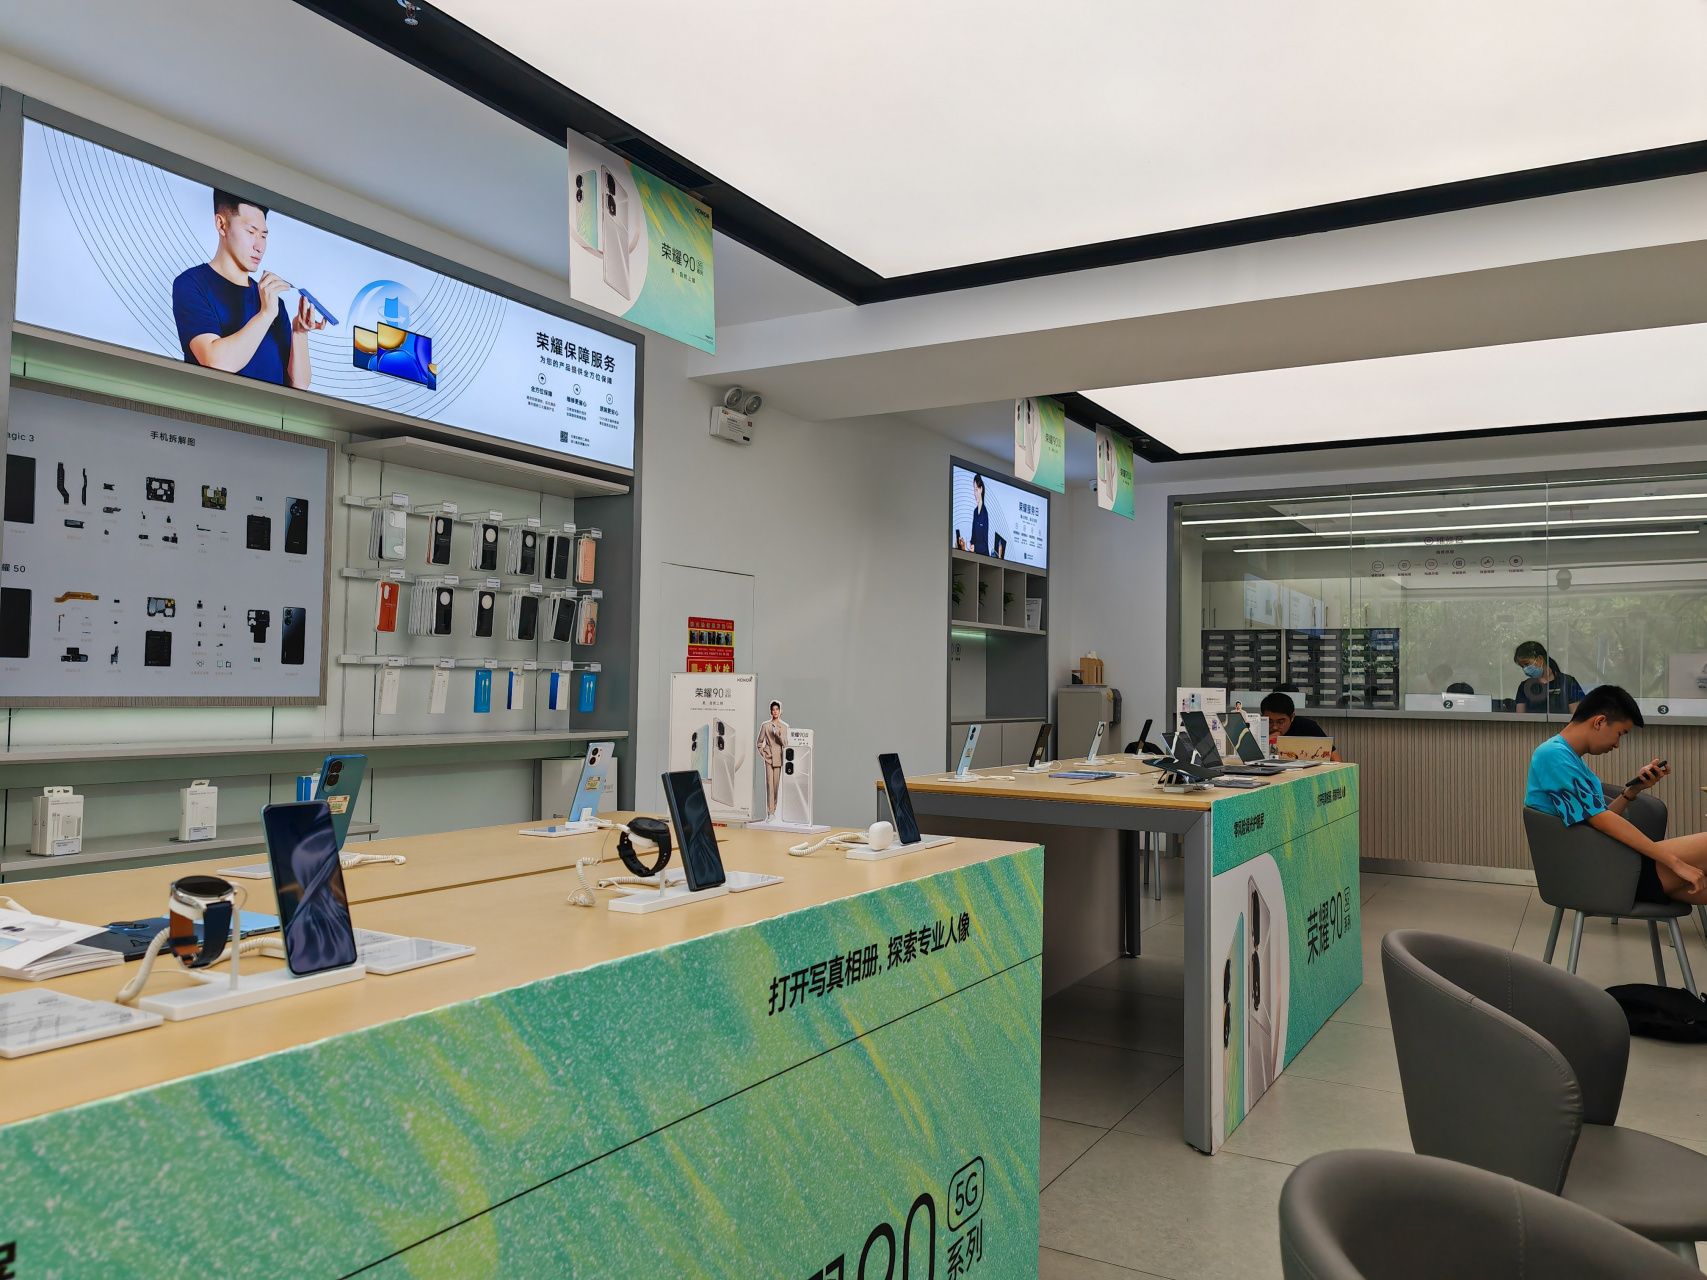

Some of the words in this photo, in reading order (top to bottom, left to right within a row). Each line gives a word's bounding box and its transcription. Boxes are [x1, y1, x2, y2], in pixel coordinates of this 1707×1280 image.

[695, 207, 709, 219] HONOR
[661, 242, 696, 272] 荣耀90
[536, 331, 616, 373] 荣耀保障服务
[539, 355, 613, 385] 为您的产品提供全方位保障
[6, 432, 26, 441] agic
[28, 434, 35, 442] 3
[150, 430, 196, 446] 手机拆解图
[13, 564, 26, 573] 50
[694, 687, 724, 699] 荣耀90
[1307, 891, 1343, 966] 荣耀90
[768, 910, 970, 1017] 打开写真相册，探索专业人像
[955, 1171, 978, 1216] 5G
[947, 1218, 983, 1280] 系列
